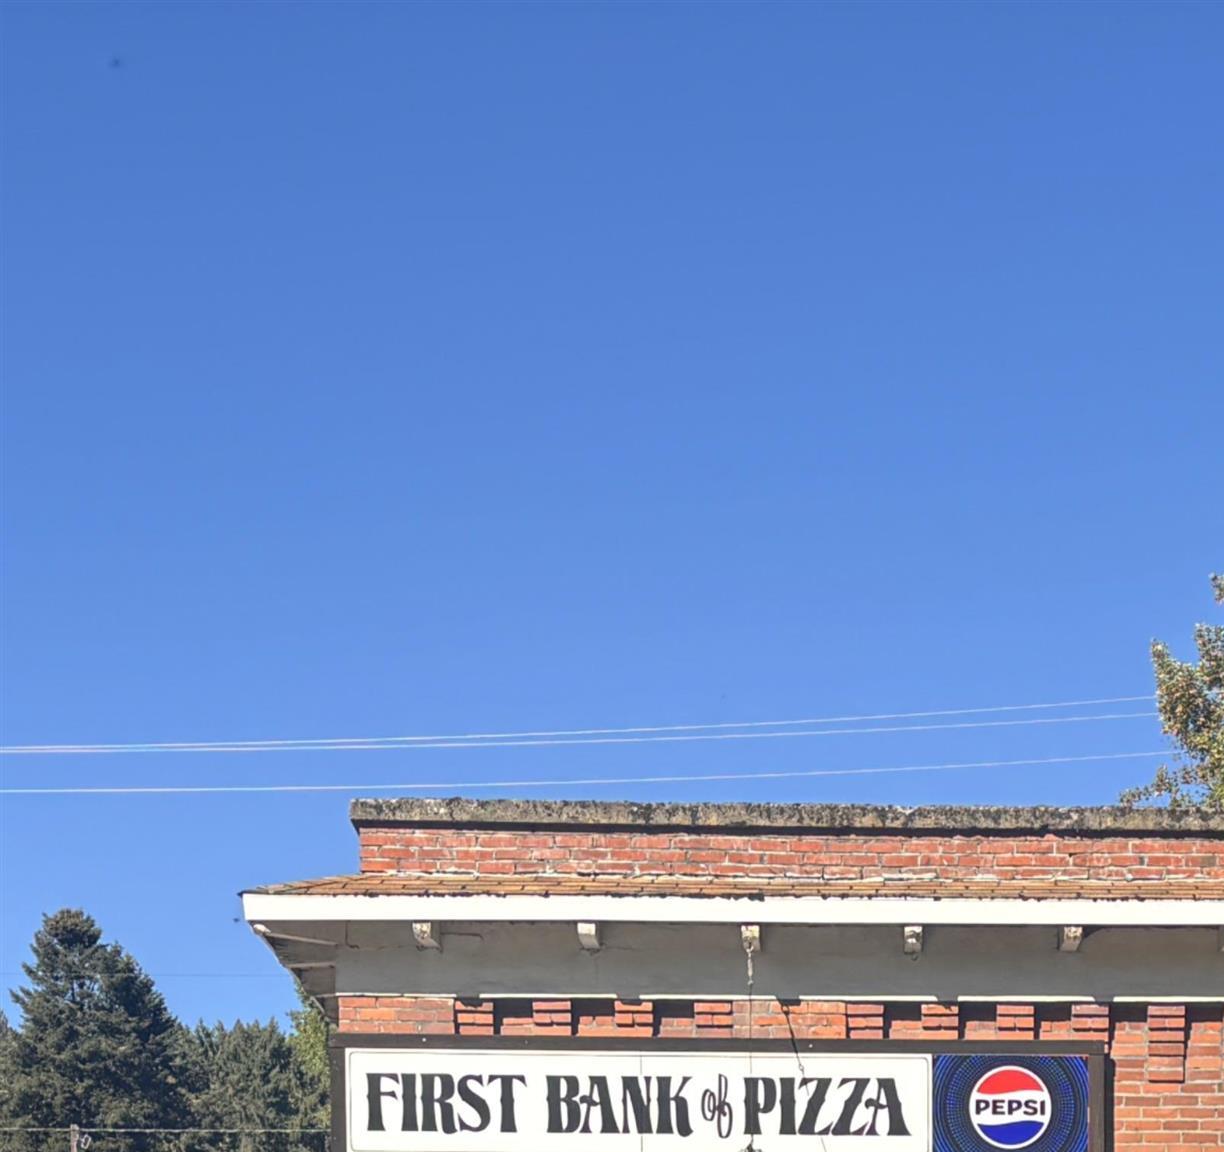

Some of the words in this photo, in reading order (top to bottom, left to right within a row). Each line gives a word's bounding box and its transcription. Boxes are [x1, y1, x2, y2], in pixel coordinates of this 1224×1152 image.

[366, 1072, 528, 1135] FIRST
[545, 1075, 694, 1138] BANK
[701, 1073, 733, 1139] of
[743, 1077, 912, 1137] PIZZA
[975, 1098, 1046, 1116] PEPSI
